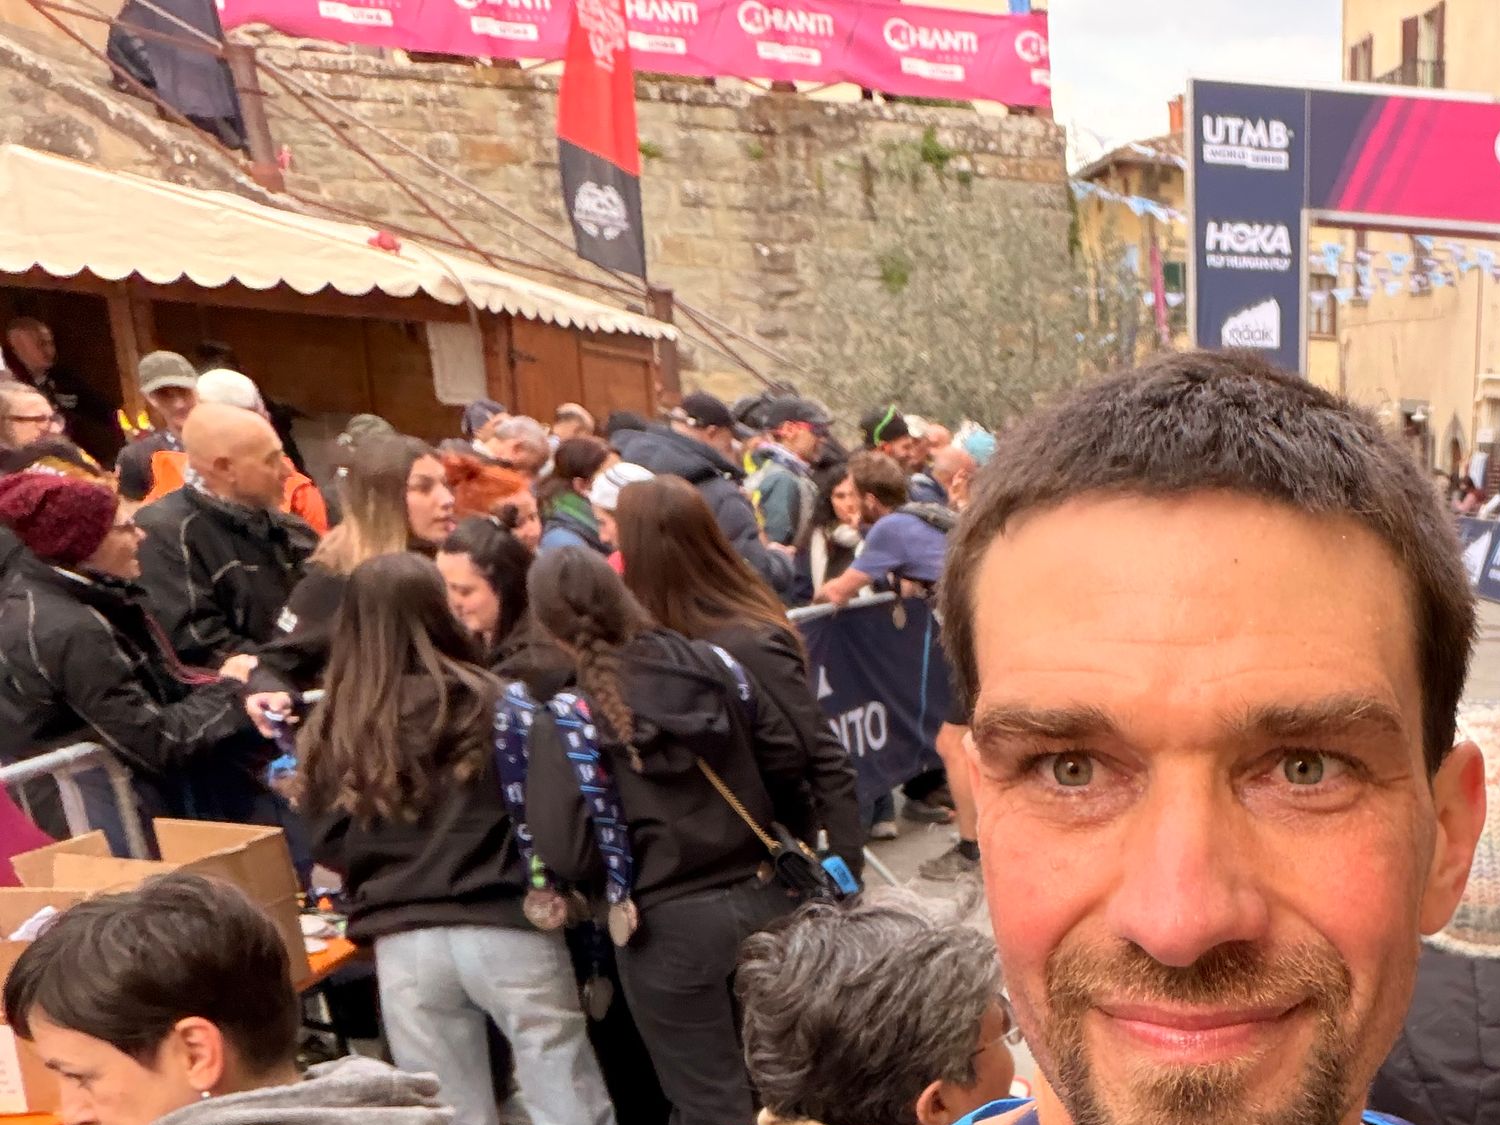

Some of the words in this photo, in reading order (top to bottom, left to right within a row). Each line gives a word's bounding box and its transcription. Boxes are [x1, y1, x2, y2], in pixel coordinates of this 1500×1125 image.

[626, 0, 698, 25] HIANTI
[737, 0, 834, 36] CHIANTI
[883, 17, 978, 54] CHIANTI
[1202, 114, 1290, 149] UTMB
[1205, 221, 1292, 256] HOKA
